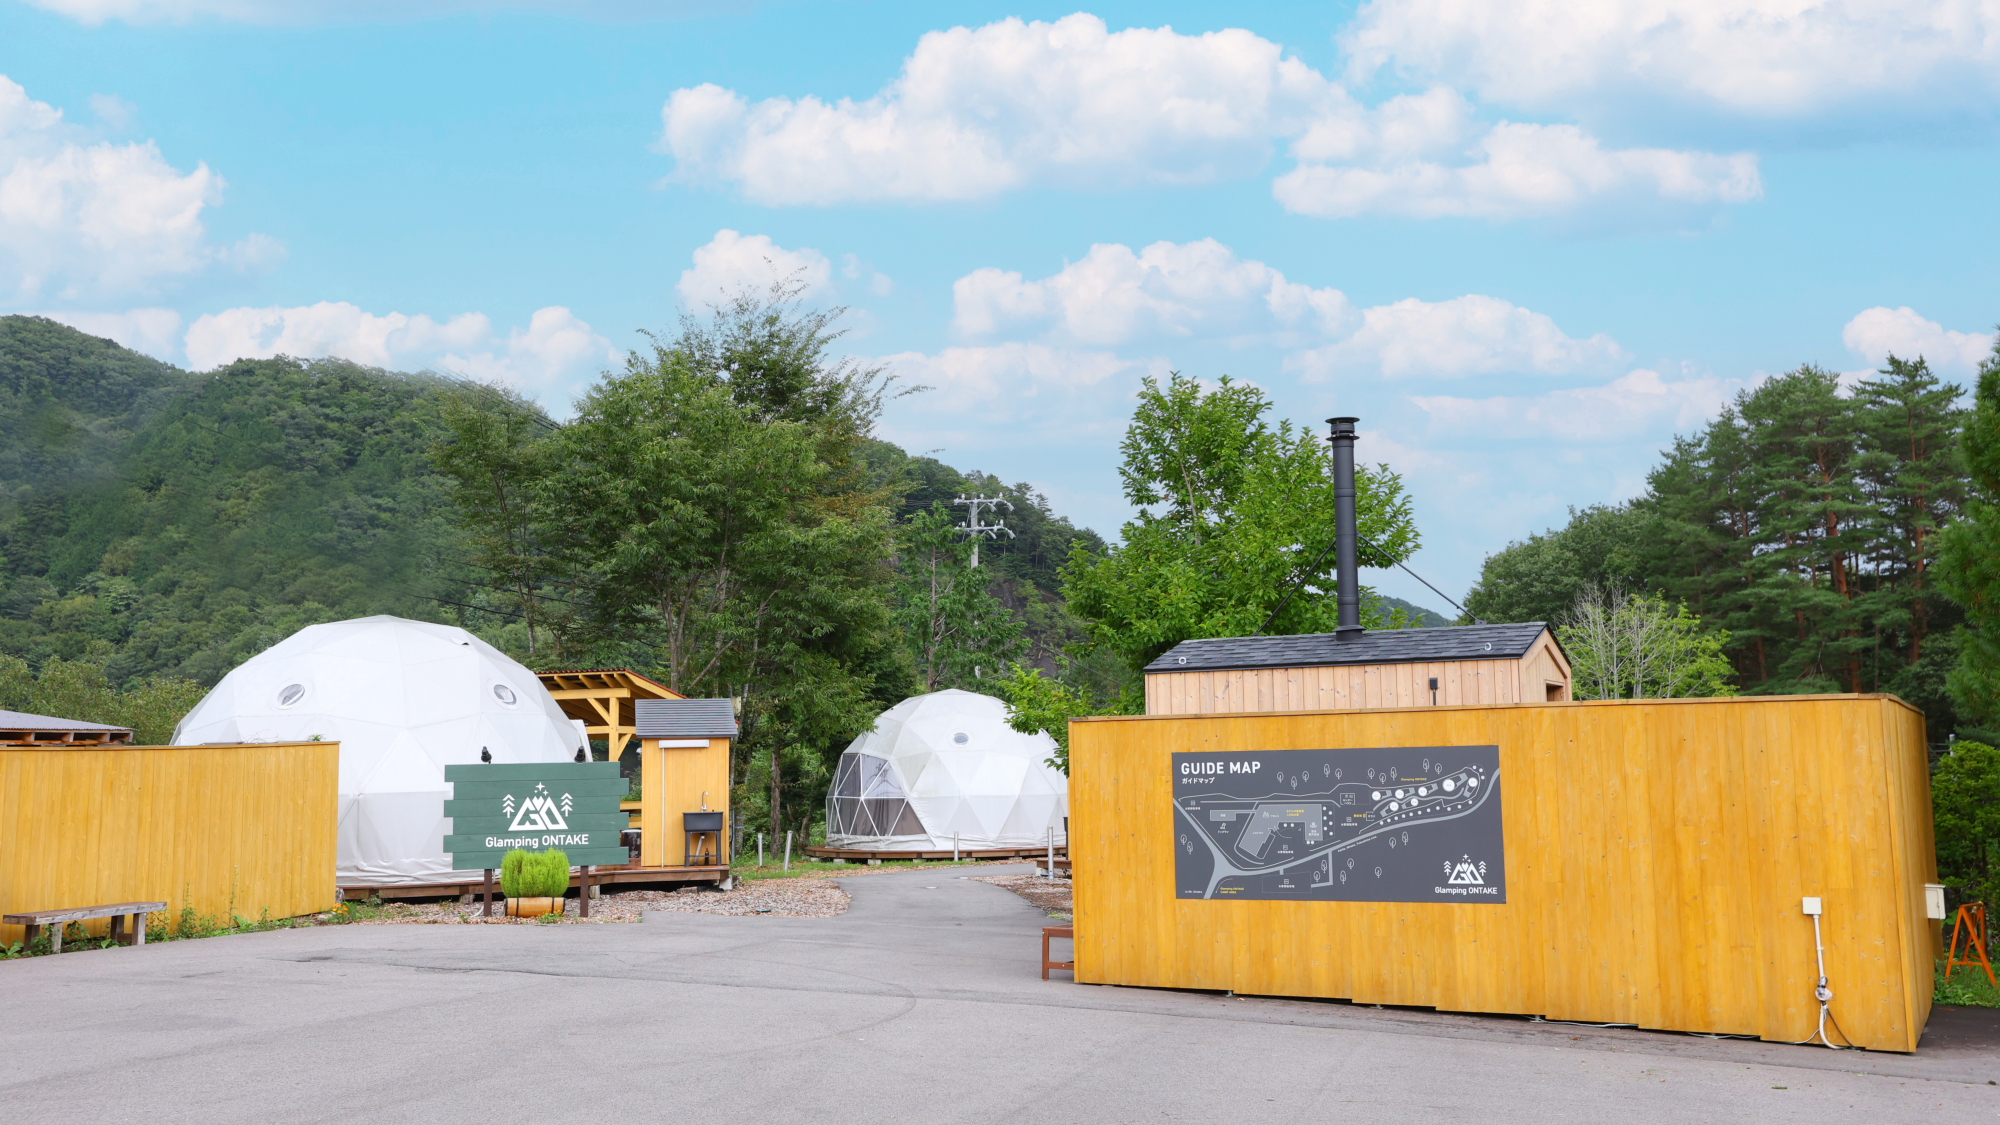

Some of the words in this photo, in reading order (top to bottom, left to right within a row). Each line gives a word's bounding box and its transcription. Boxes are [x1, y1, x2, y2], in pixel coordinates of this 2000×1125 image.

[1181, 762, 1225, 775] GUIDE
[1229, 761, 1261, 774] MAP
[485, 836, 539, 849] Glamping
[541, 834, 589, 846] ONTAKE
[1434, 886, 1467, 895] Glamping
[1468, 886, 1498, 895] ONTAKE
